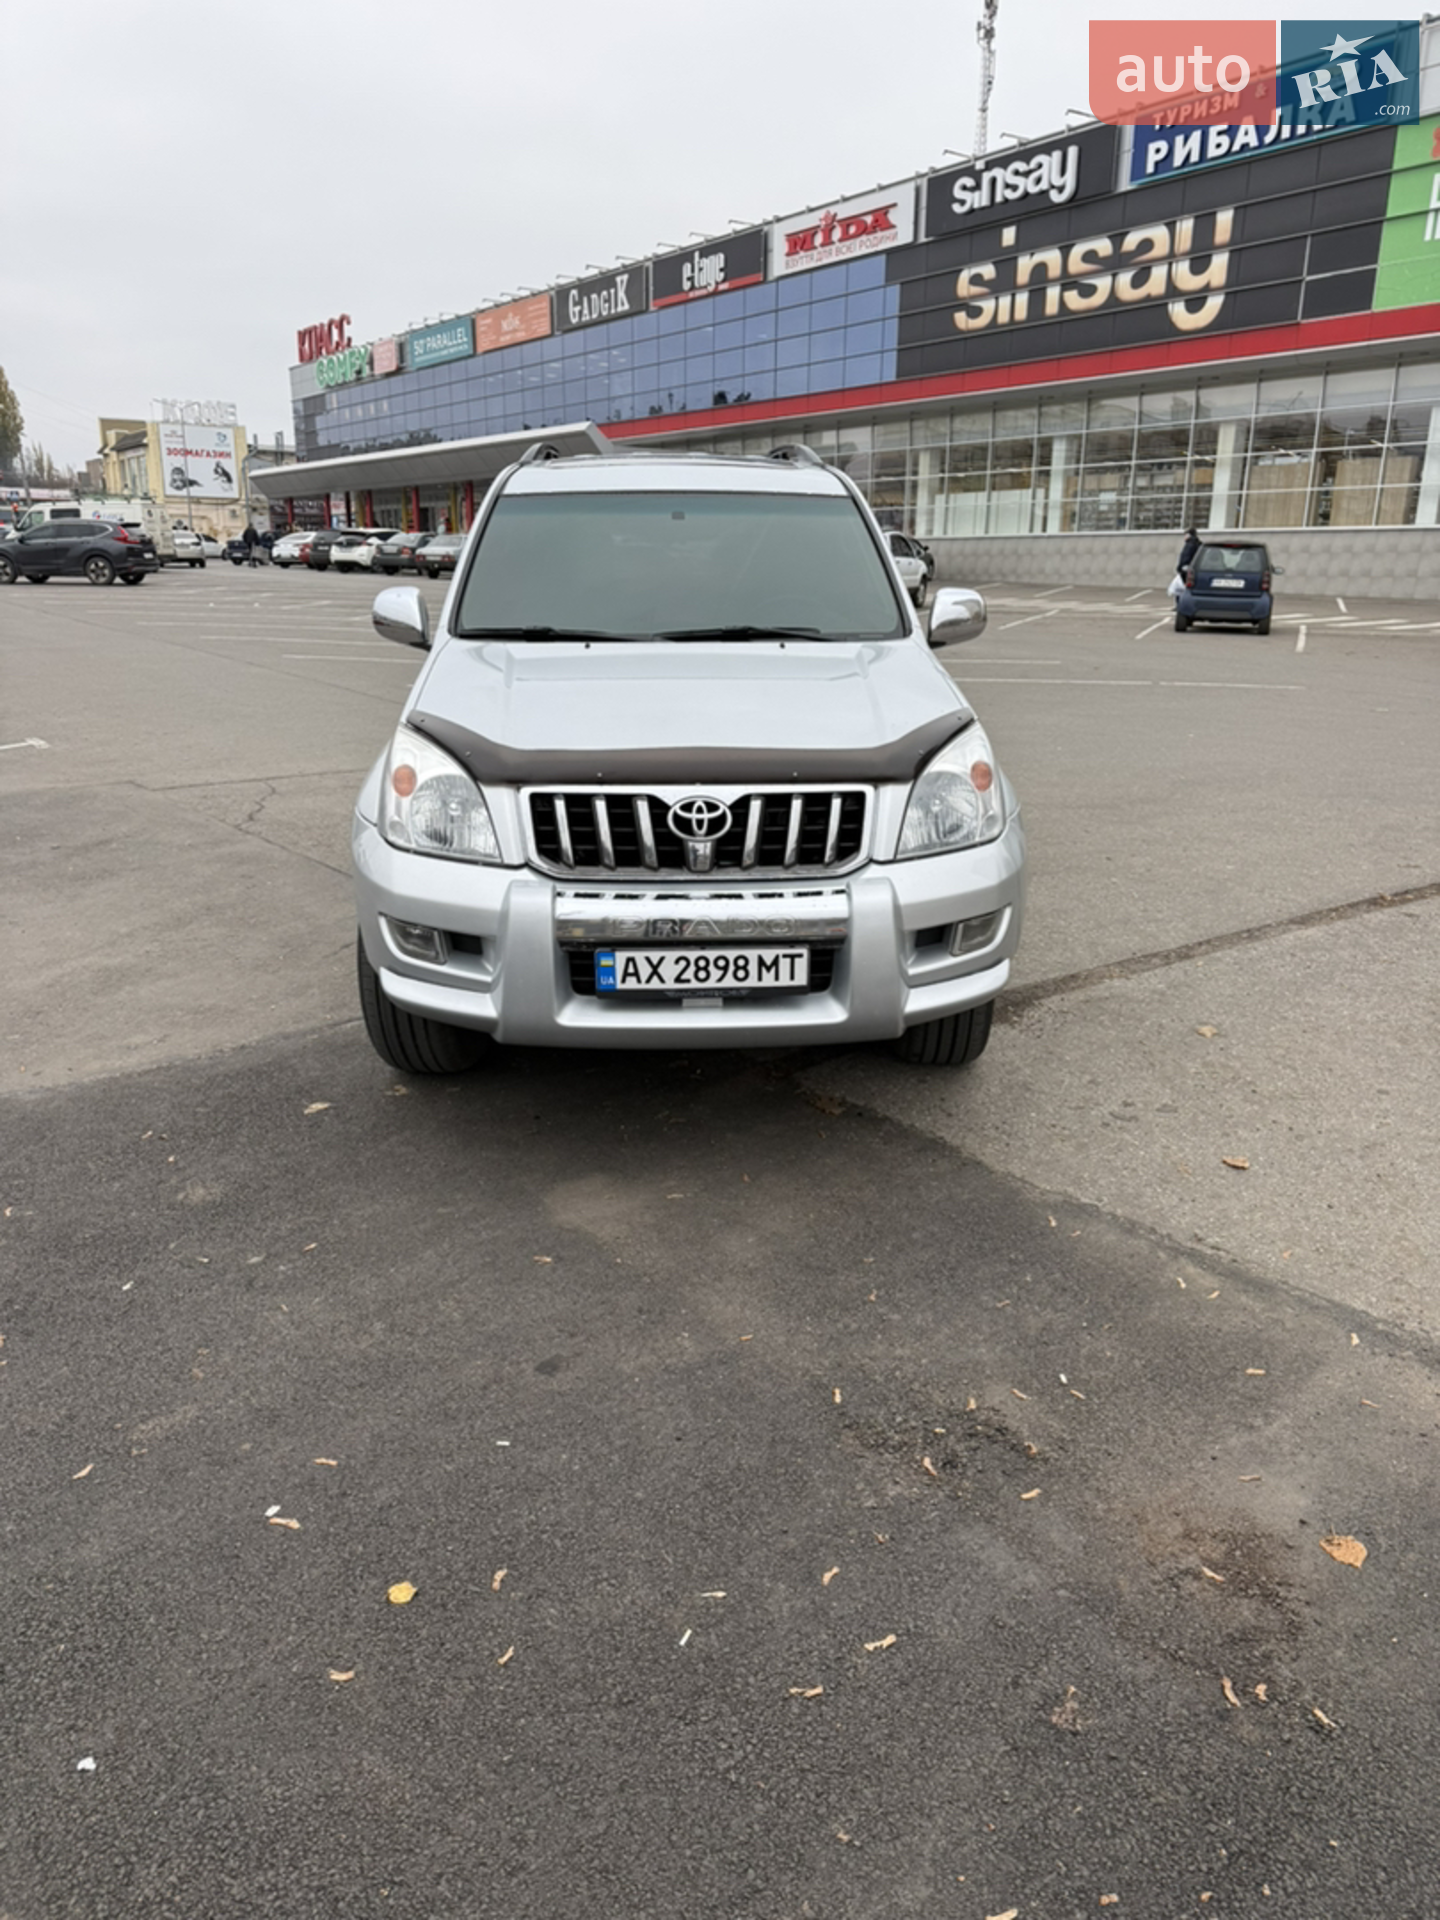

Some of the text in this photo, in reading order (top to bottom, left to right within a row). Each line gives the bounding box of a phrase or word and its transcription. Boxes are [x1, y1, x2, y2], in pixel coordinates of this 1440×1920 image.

[1152, 90, 1241, 131] ТУРИЗМ
[1145, 90, 1357, 175] РИБАЛКА
[951, 145, 1080, 214] sinsay
[858, 231, 898, 251] РОДИНИ
[953, 207, 1235, 331] sinsay
[316, 345, 368, 388] COMFY
[166, 447, 232, 460] ЗООМАГАЗИН
[611, 914, 796, 937] PRADO
[600, 976, 615, 985] UA
